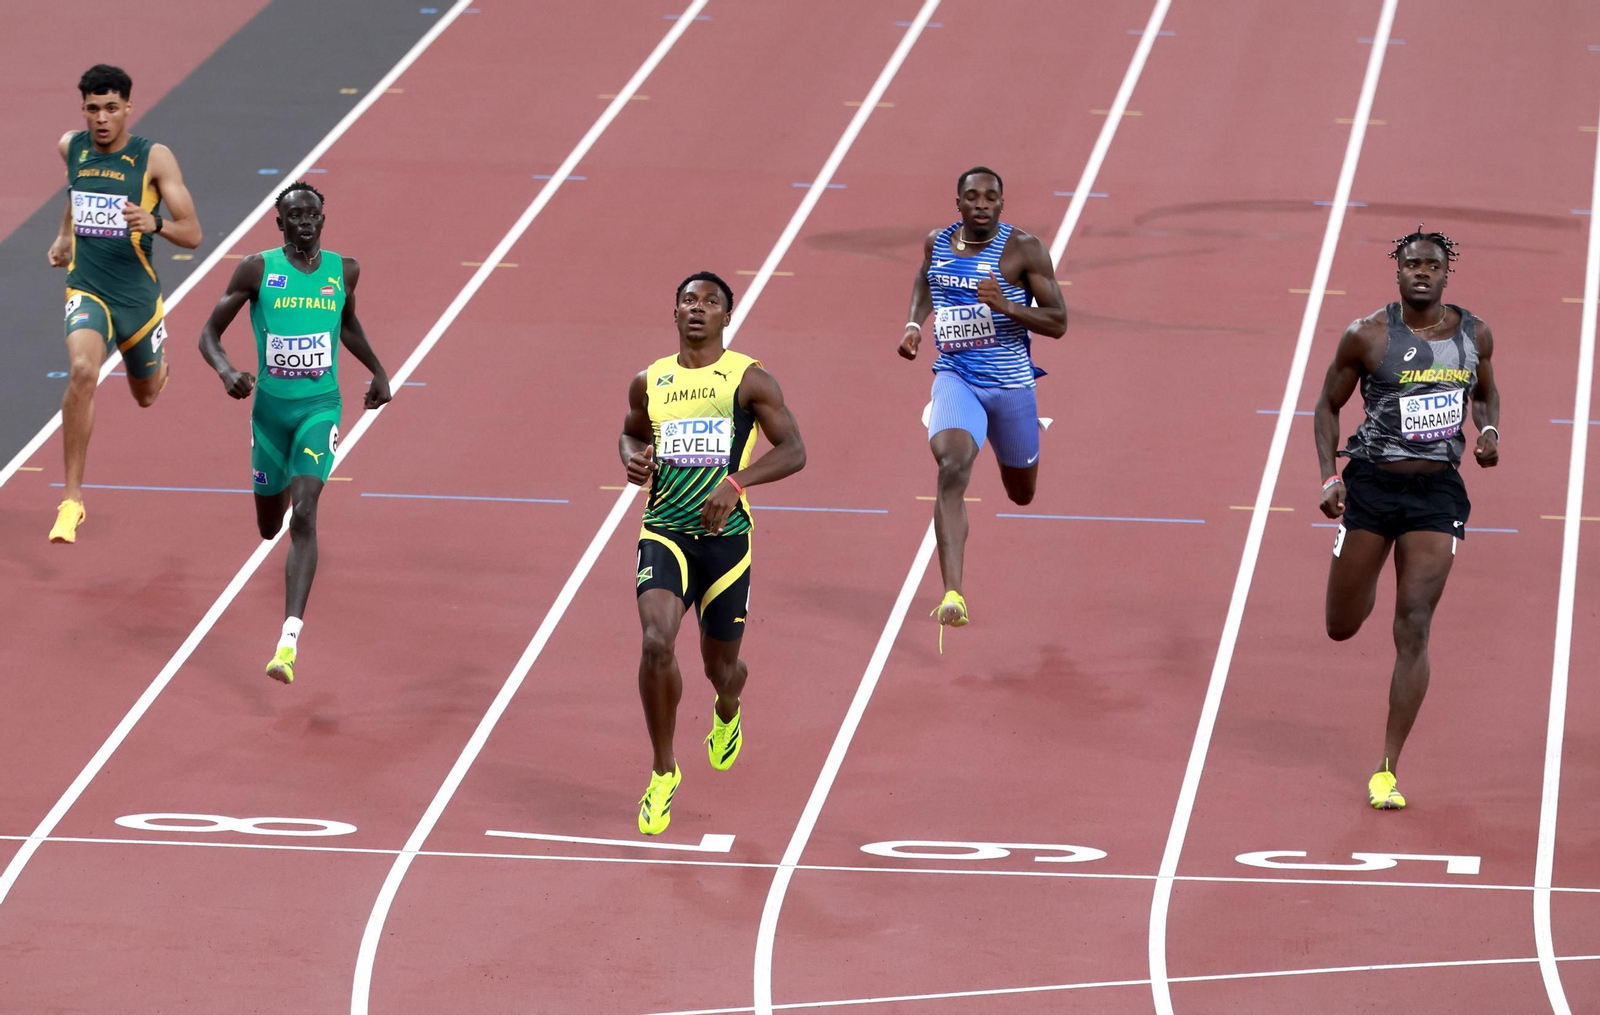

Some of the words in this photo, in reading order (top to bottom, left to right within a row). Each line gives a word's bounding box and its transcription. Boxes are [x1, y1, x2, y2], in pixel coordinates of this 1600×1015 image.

[77, 168, 100, 178] SOUTH
[101, 169, 125, 181] AFRICA
[85, 195, 122, 210] TDK
[76, 211, 118, 226] JACK
[934, 274, 982, 290] ISRAE
[273, 296, 336, 312] AUSTRALIA
[949, 306, 987, 321] TDK
[939, 322, 992, 339] AFRIFAH
[283, 335, 326, 350] TDK
[274, 352, 325, 367] GOUT
[1399, 368, 1471, 384] ZIMBABWE
[663, 387, 716, 404] JAMAICA
[1419, 392, 1459, 410] TDK
[678, 420, 725, 434] TDK
[1405, 408, 1460, 430] CHARAMBA
[663, 438, 726, 454] LEVELL
[114, 813, 358, 837] 8
[484, 829, 736, 853] 7
[860, 840, 1108, 864] 6
[1234, 849, 1481, 875] 5
